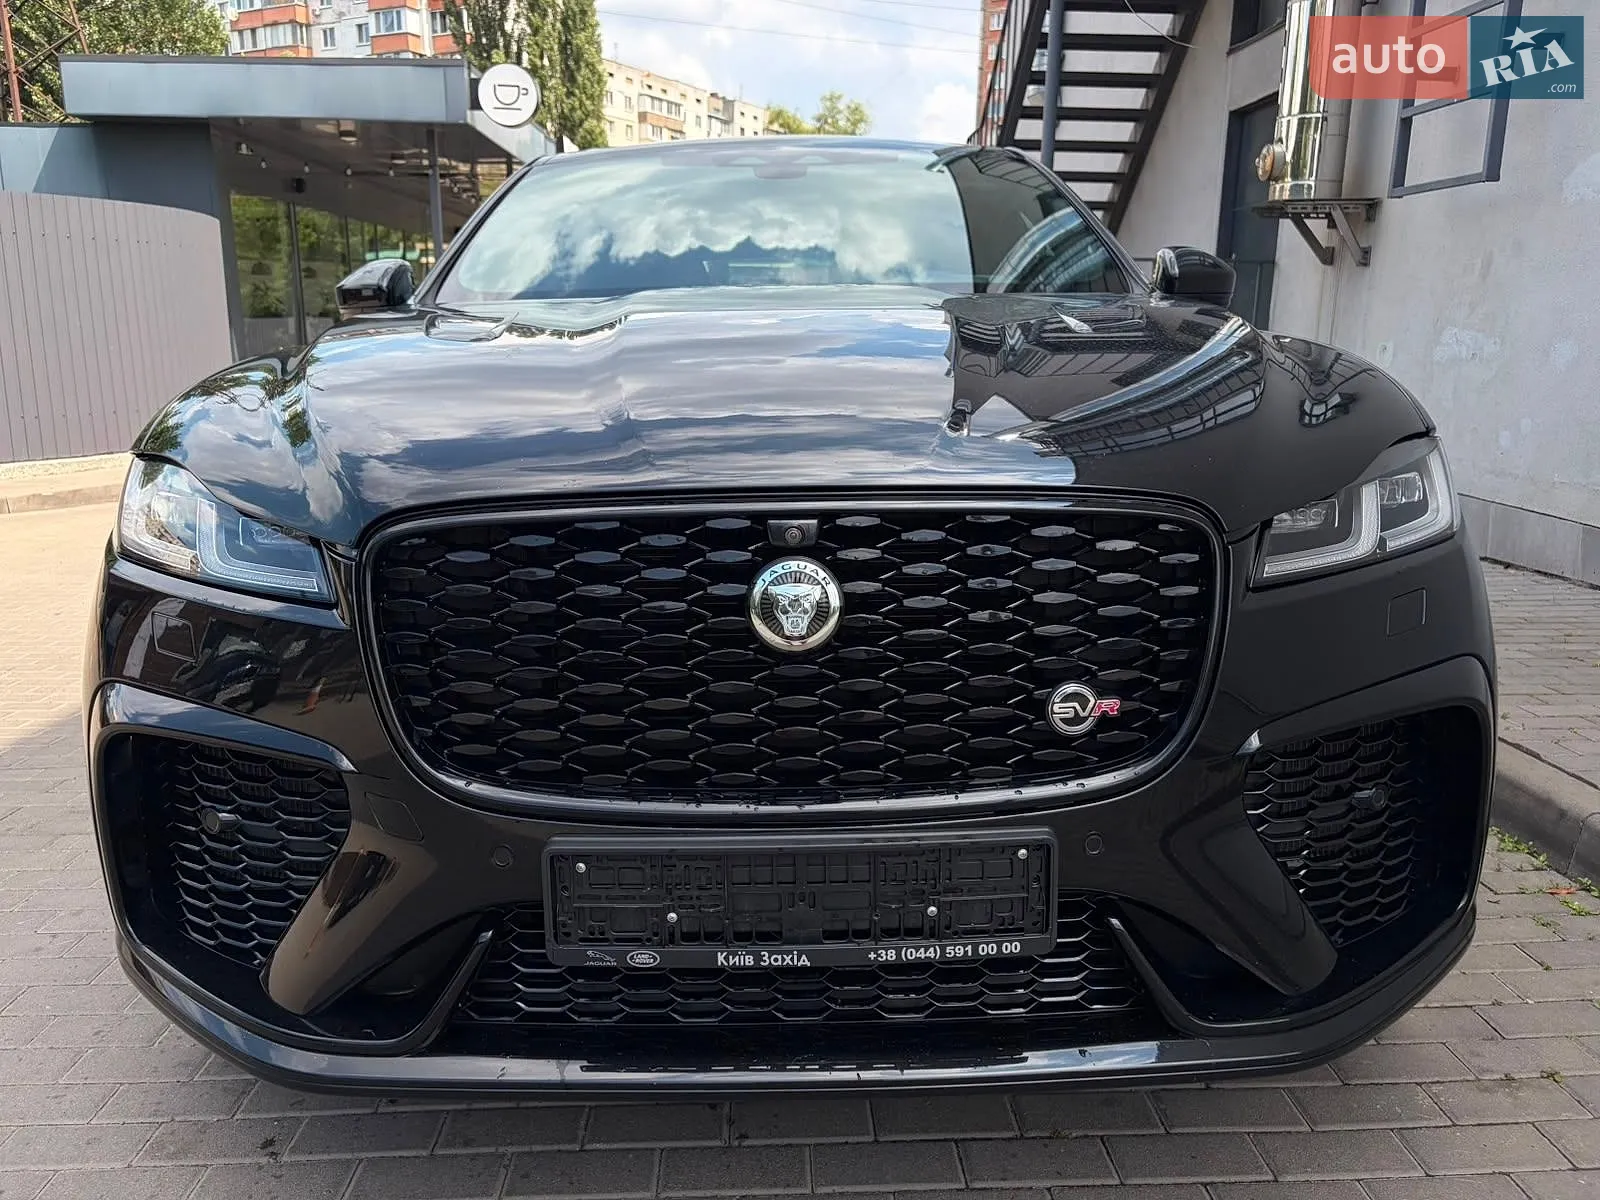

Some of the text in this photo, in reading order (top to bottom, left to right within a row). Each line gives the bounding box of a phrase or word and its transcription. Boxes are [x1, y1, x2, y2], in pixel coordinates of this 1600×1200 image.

[761, 563, 831, 587] JAGUAR
[717, 951, 811, 967] Київ Захід
[868, 941, 1021, 961] +38 (044) 591 00 00
